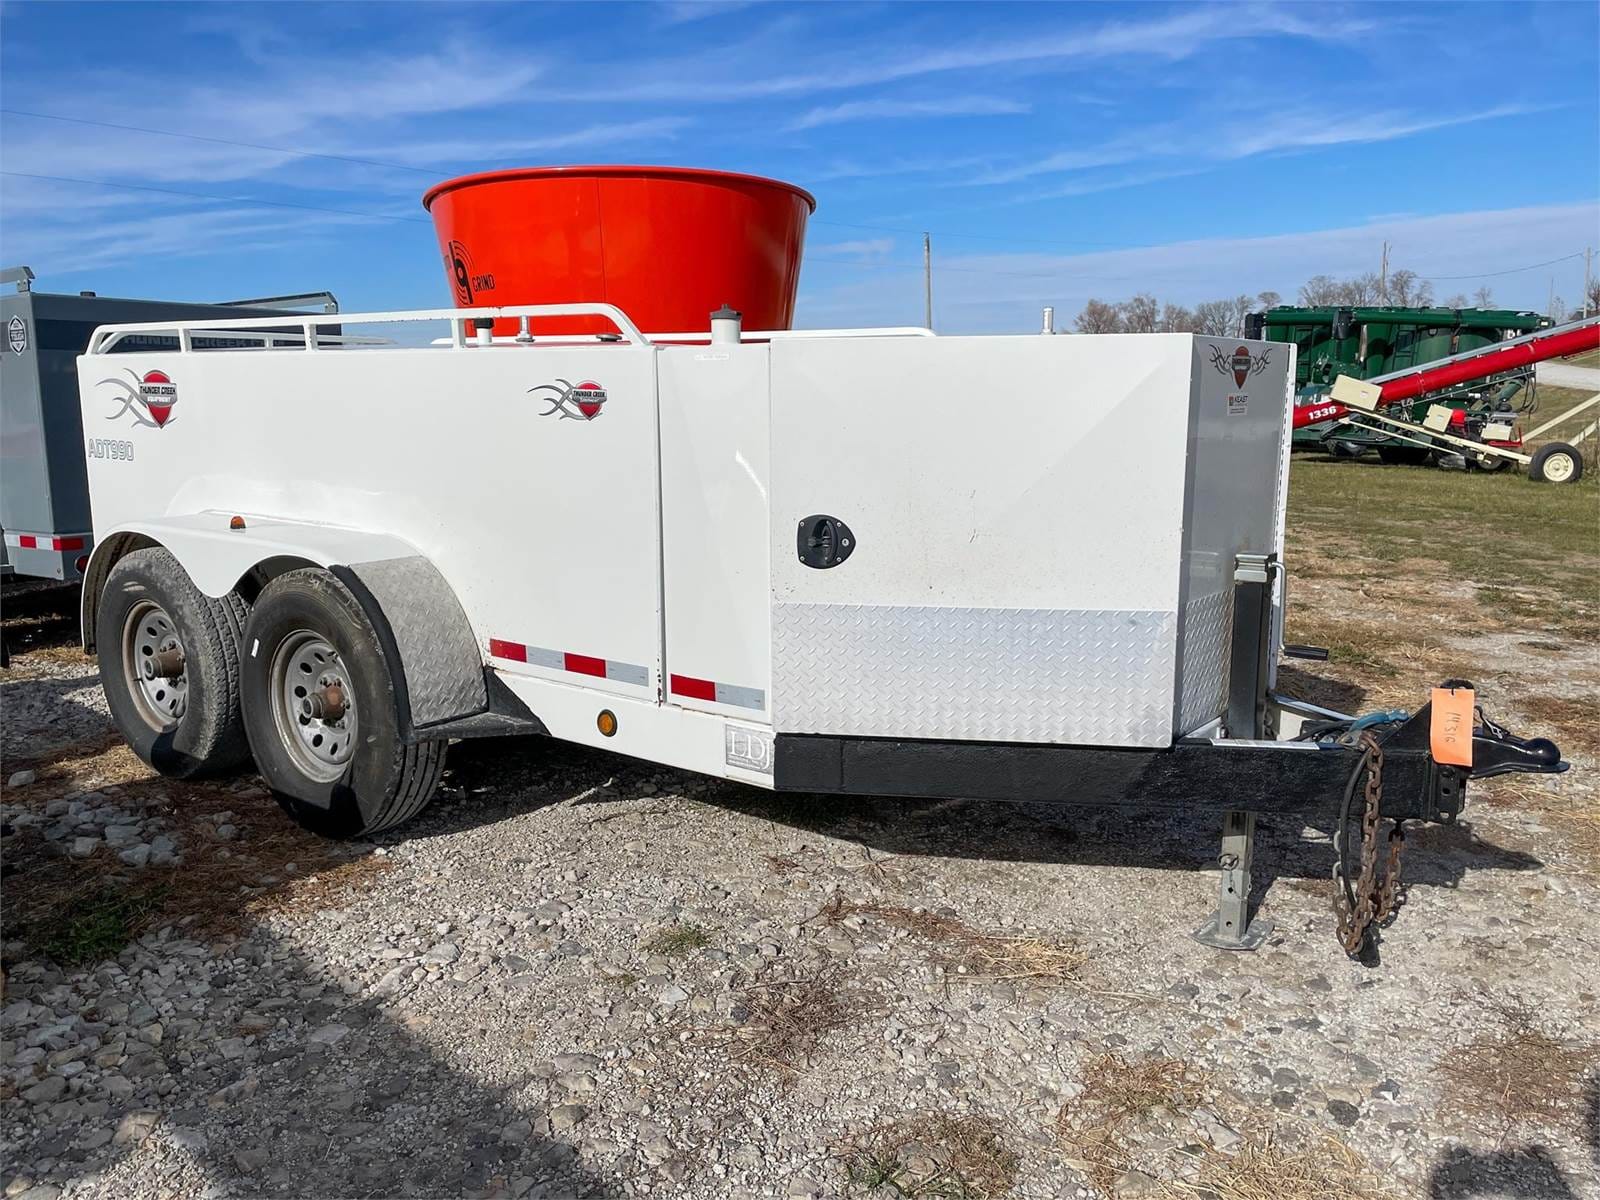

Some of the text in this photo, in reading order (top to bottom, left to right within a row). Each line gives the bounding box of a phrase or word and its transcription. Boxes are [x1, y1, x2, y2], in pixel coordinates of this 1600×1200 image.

[472, 273, 496, 292] GRIND
[140, 386, 176, 395] THUNDER CREEK
[1308, 405, 1337, 420] 1336
[88, 438, 134, 461] ADT990
